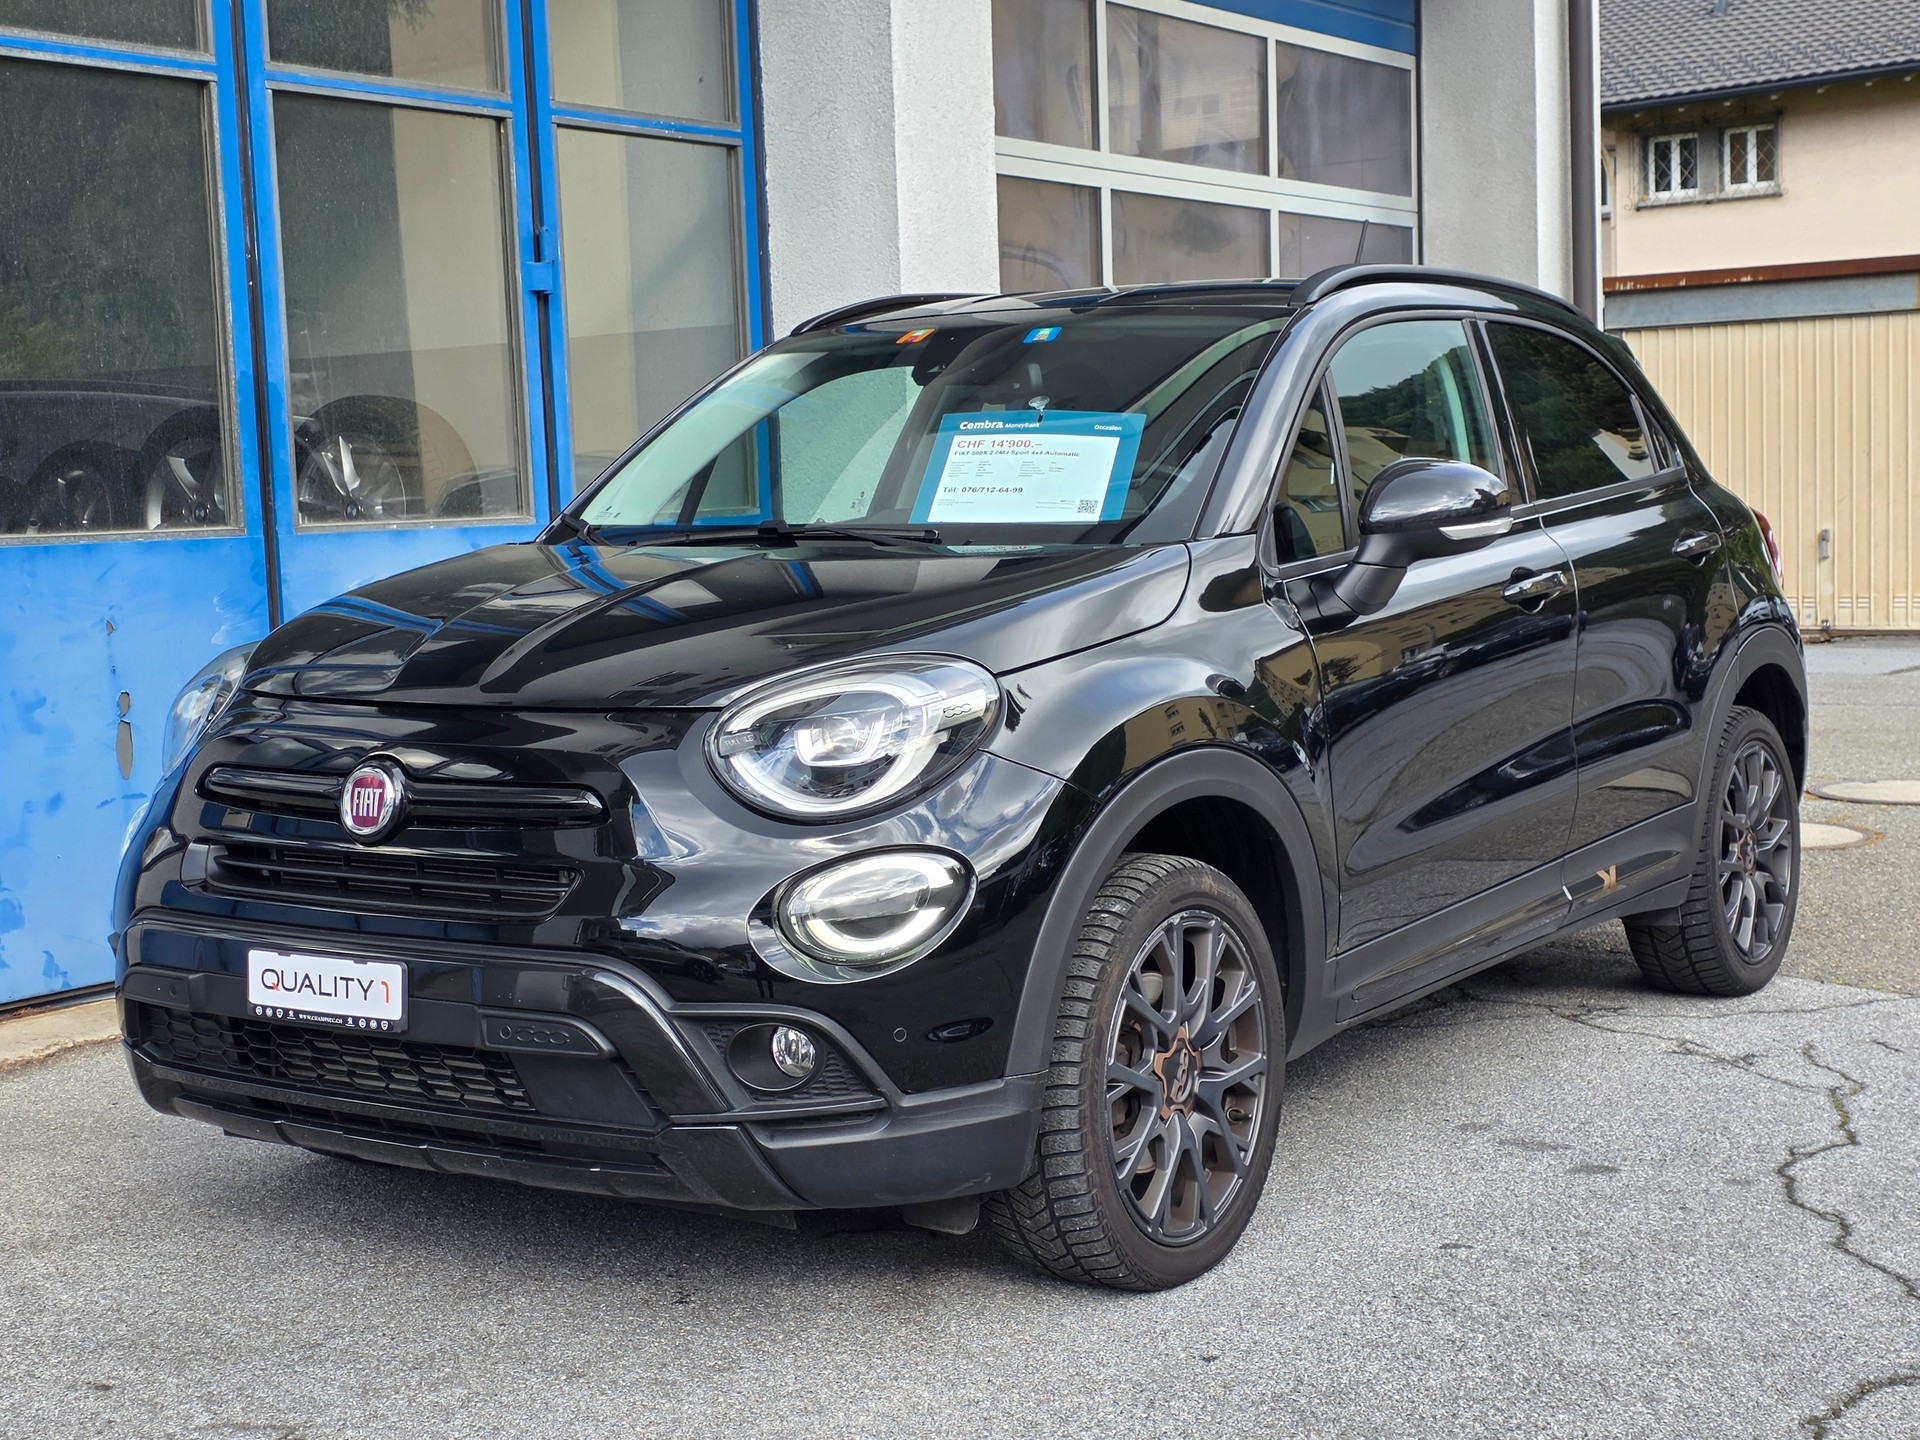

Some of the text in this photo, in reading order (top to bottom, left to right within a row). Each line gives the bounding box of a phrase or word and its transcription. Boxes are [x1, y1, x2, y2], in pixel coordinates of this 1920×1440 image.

[959, 419, 1004, 430] Cembra
[957, 440, 986, 448] CHF
[961, 486, 1023, 494] 076/712-64-99
[942, 702, 972, 719] 500
[352, 787, 383, 817] FIAT
